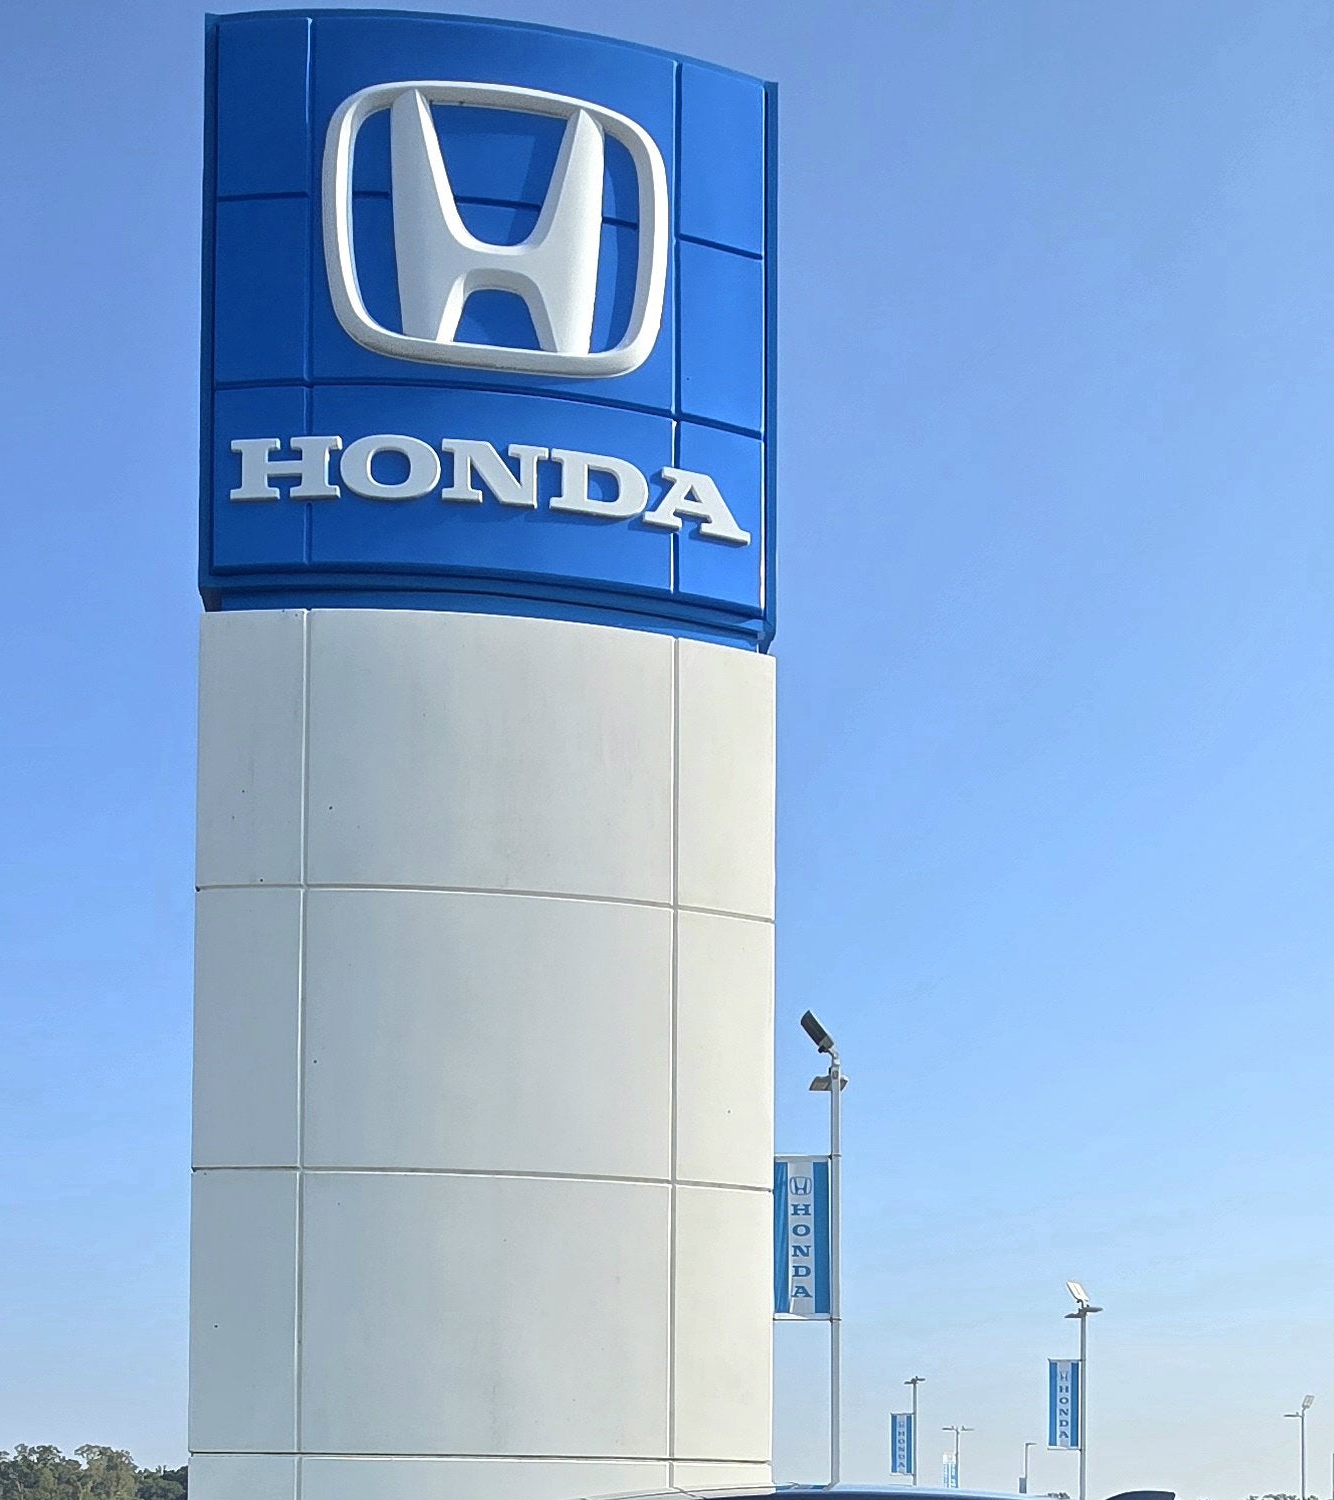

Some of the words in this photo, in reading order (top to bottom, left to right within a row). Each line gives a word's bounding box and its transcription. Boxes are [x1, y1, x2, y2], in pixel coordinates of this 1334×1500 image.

[230, 434, 751, 546] HONDA
[790, 1203, 813, 1298] HONDA
[1058, 1385, 1069, 1439] HONDA
